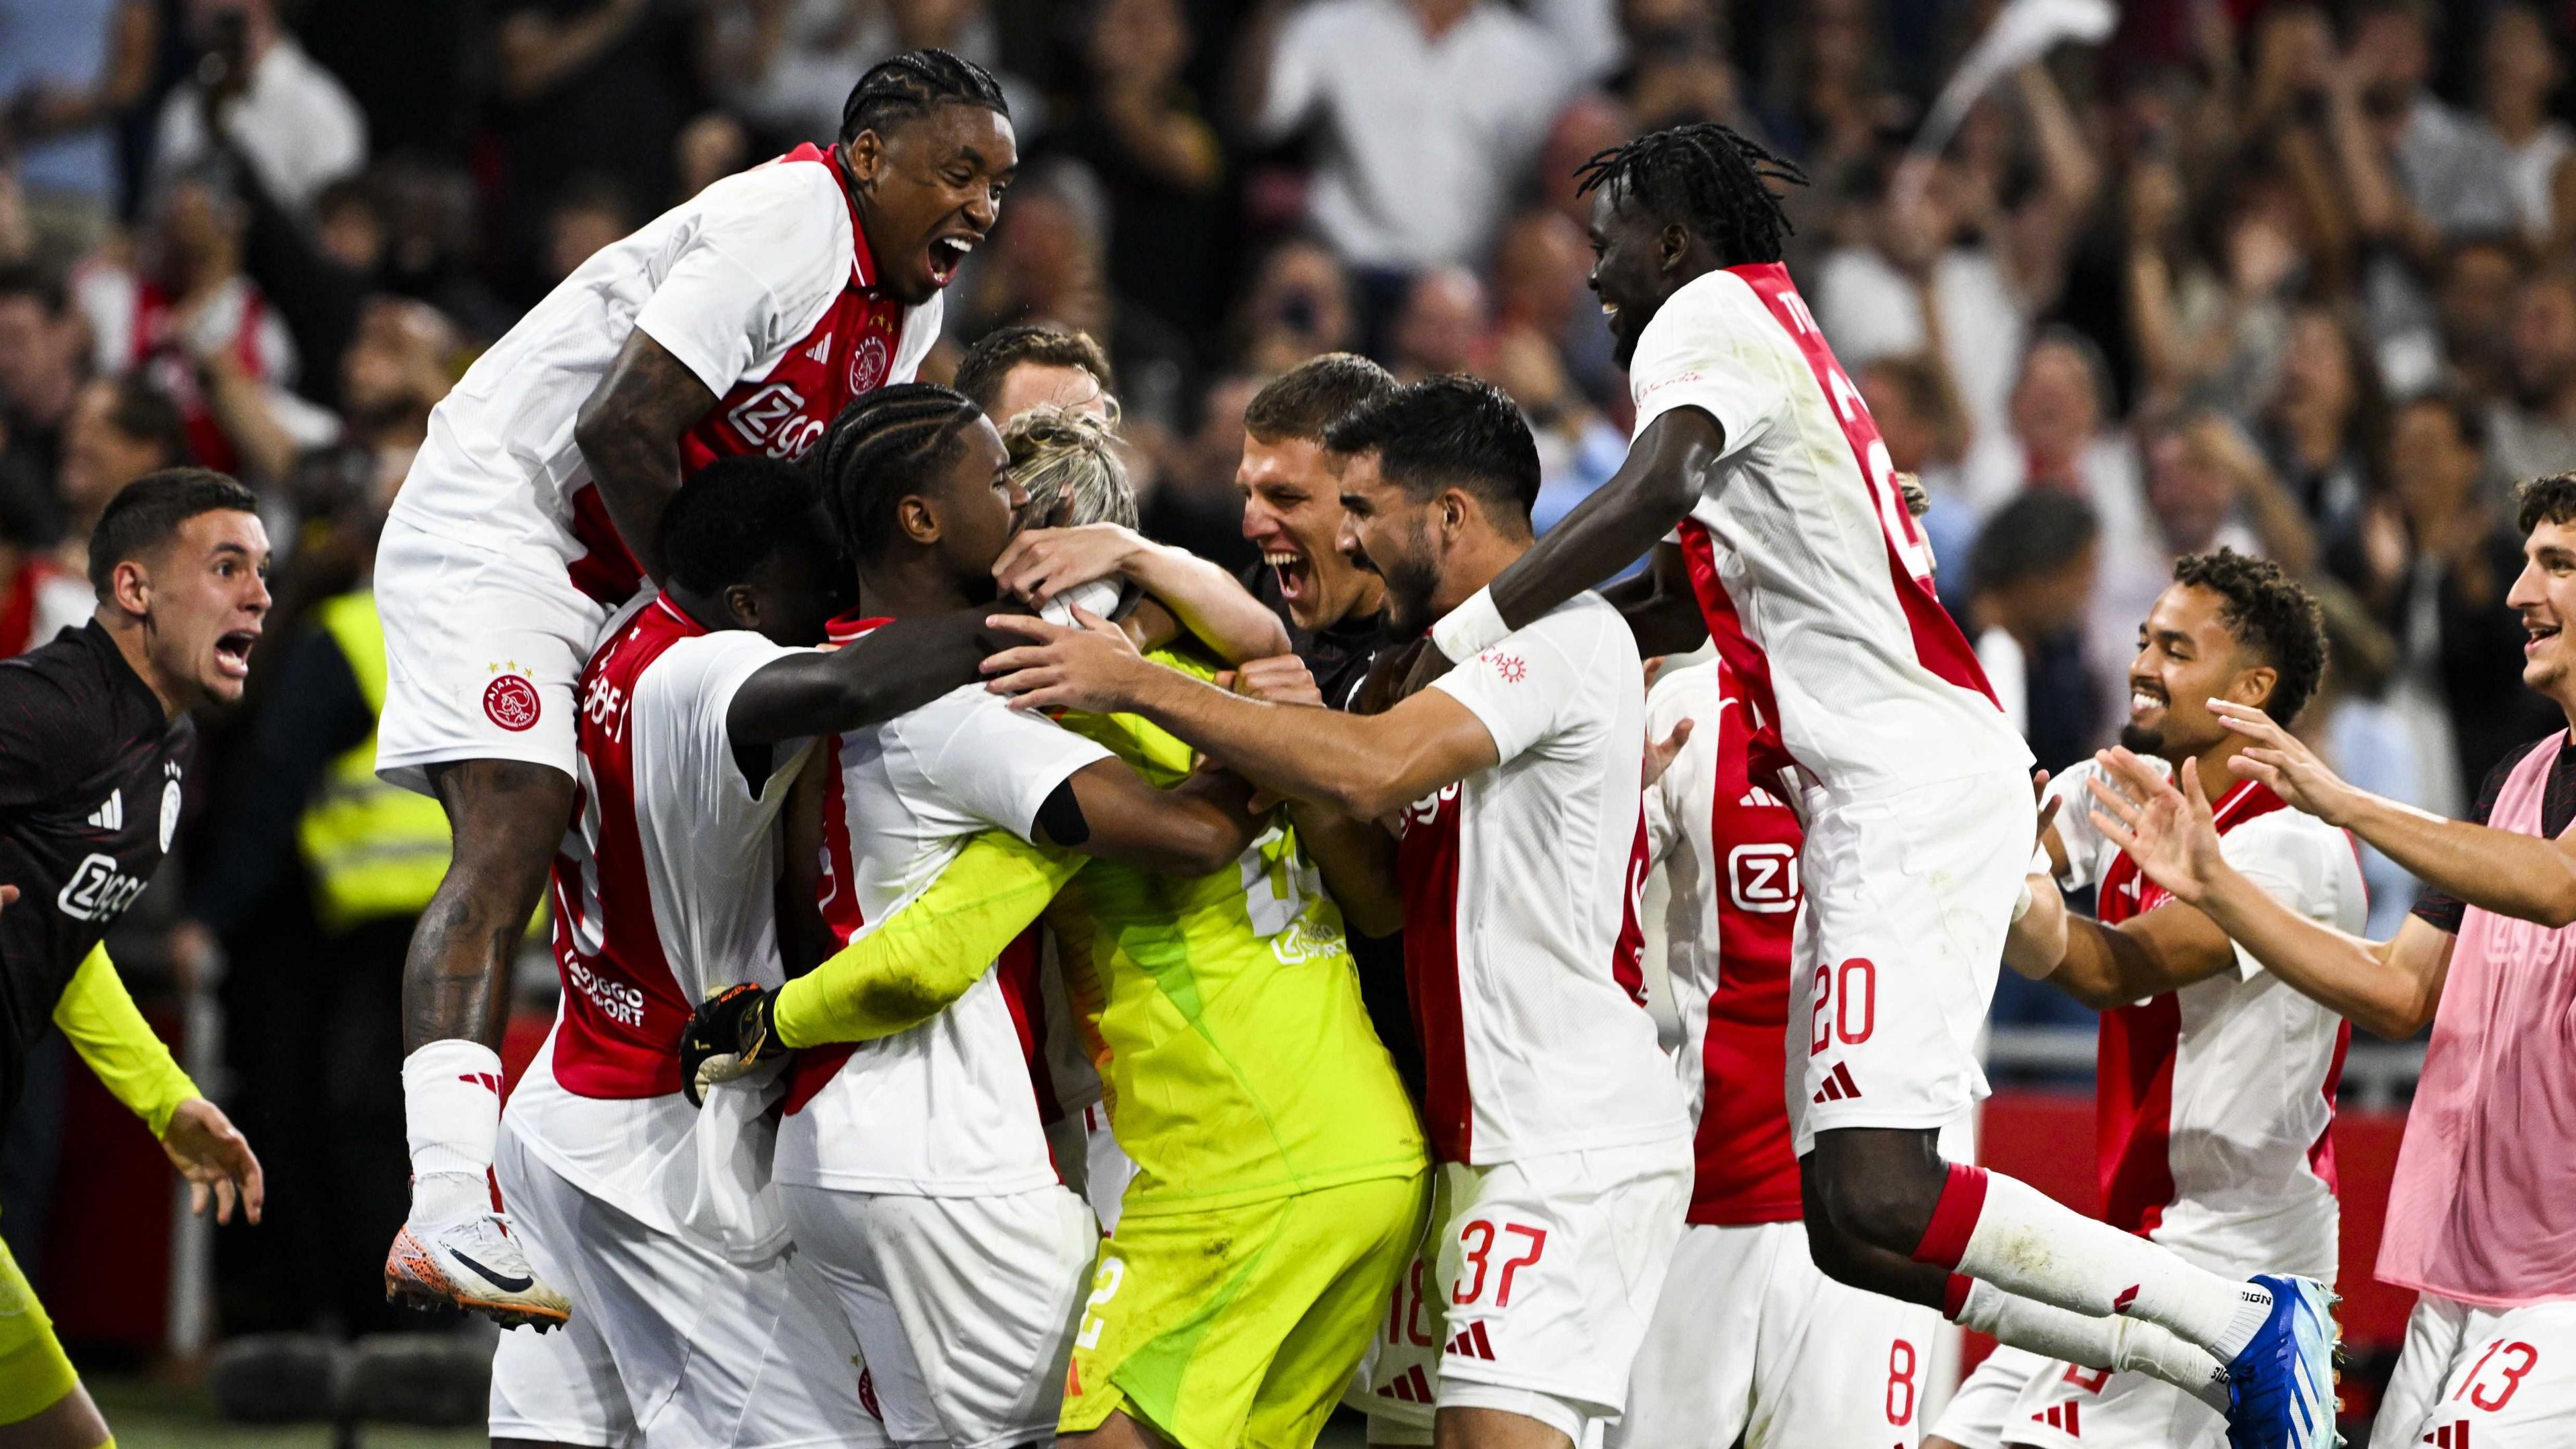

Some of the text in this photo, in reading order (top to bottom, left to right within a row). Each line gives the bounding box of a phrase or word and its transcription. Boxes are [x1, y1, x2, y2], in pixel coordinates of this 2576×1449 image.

[855, 336, 876, 360] AJAX
[488, 678, 511, 700] AJAX
[1810, 957, 1876, 1057] 20
[1452, 1219, 1548, 1308] 37
[1886, 1339, 1915, 1426] 8
[2453, 1338, 2538, 1412] 13
